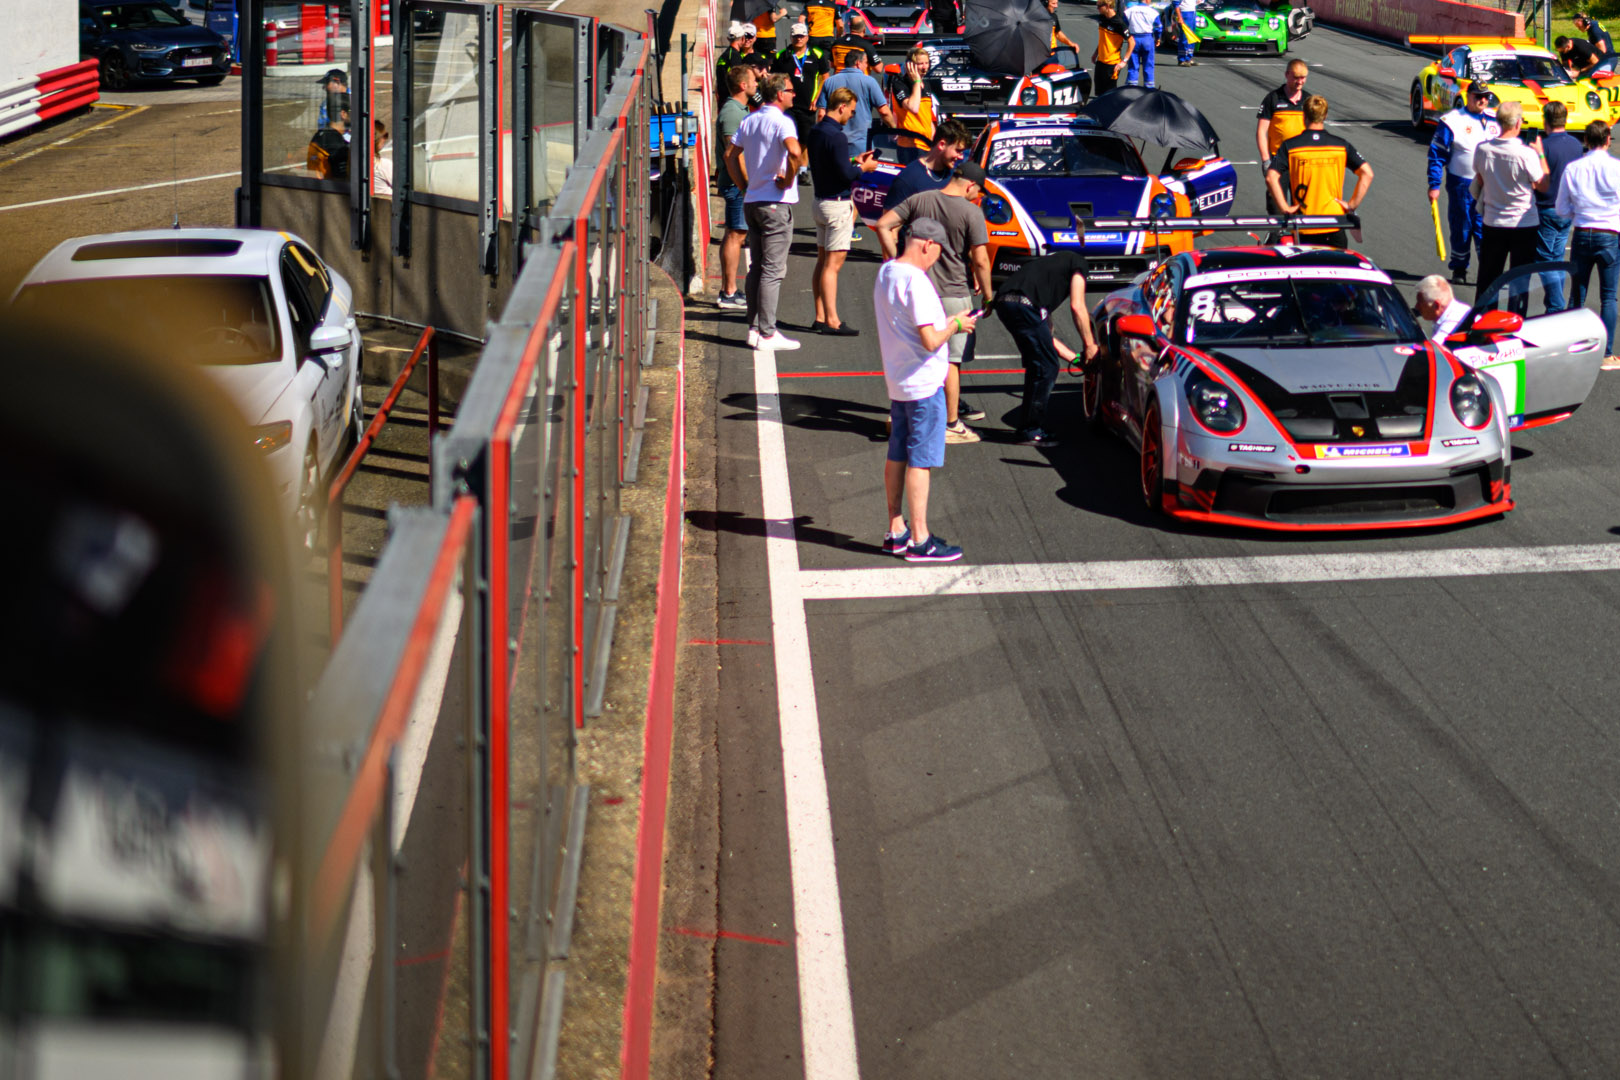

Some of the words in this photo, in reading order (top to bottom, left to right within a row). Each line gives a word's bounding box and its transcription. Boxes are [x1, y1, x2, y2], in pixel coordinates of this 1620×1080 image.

[993, 147, 1026, 166] 21
[1190, 289, 1216, 317] 8
[1342, 446, 1403, 455] MICHELIN
